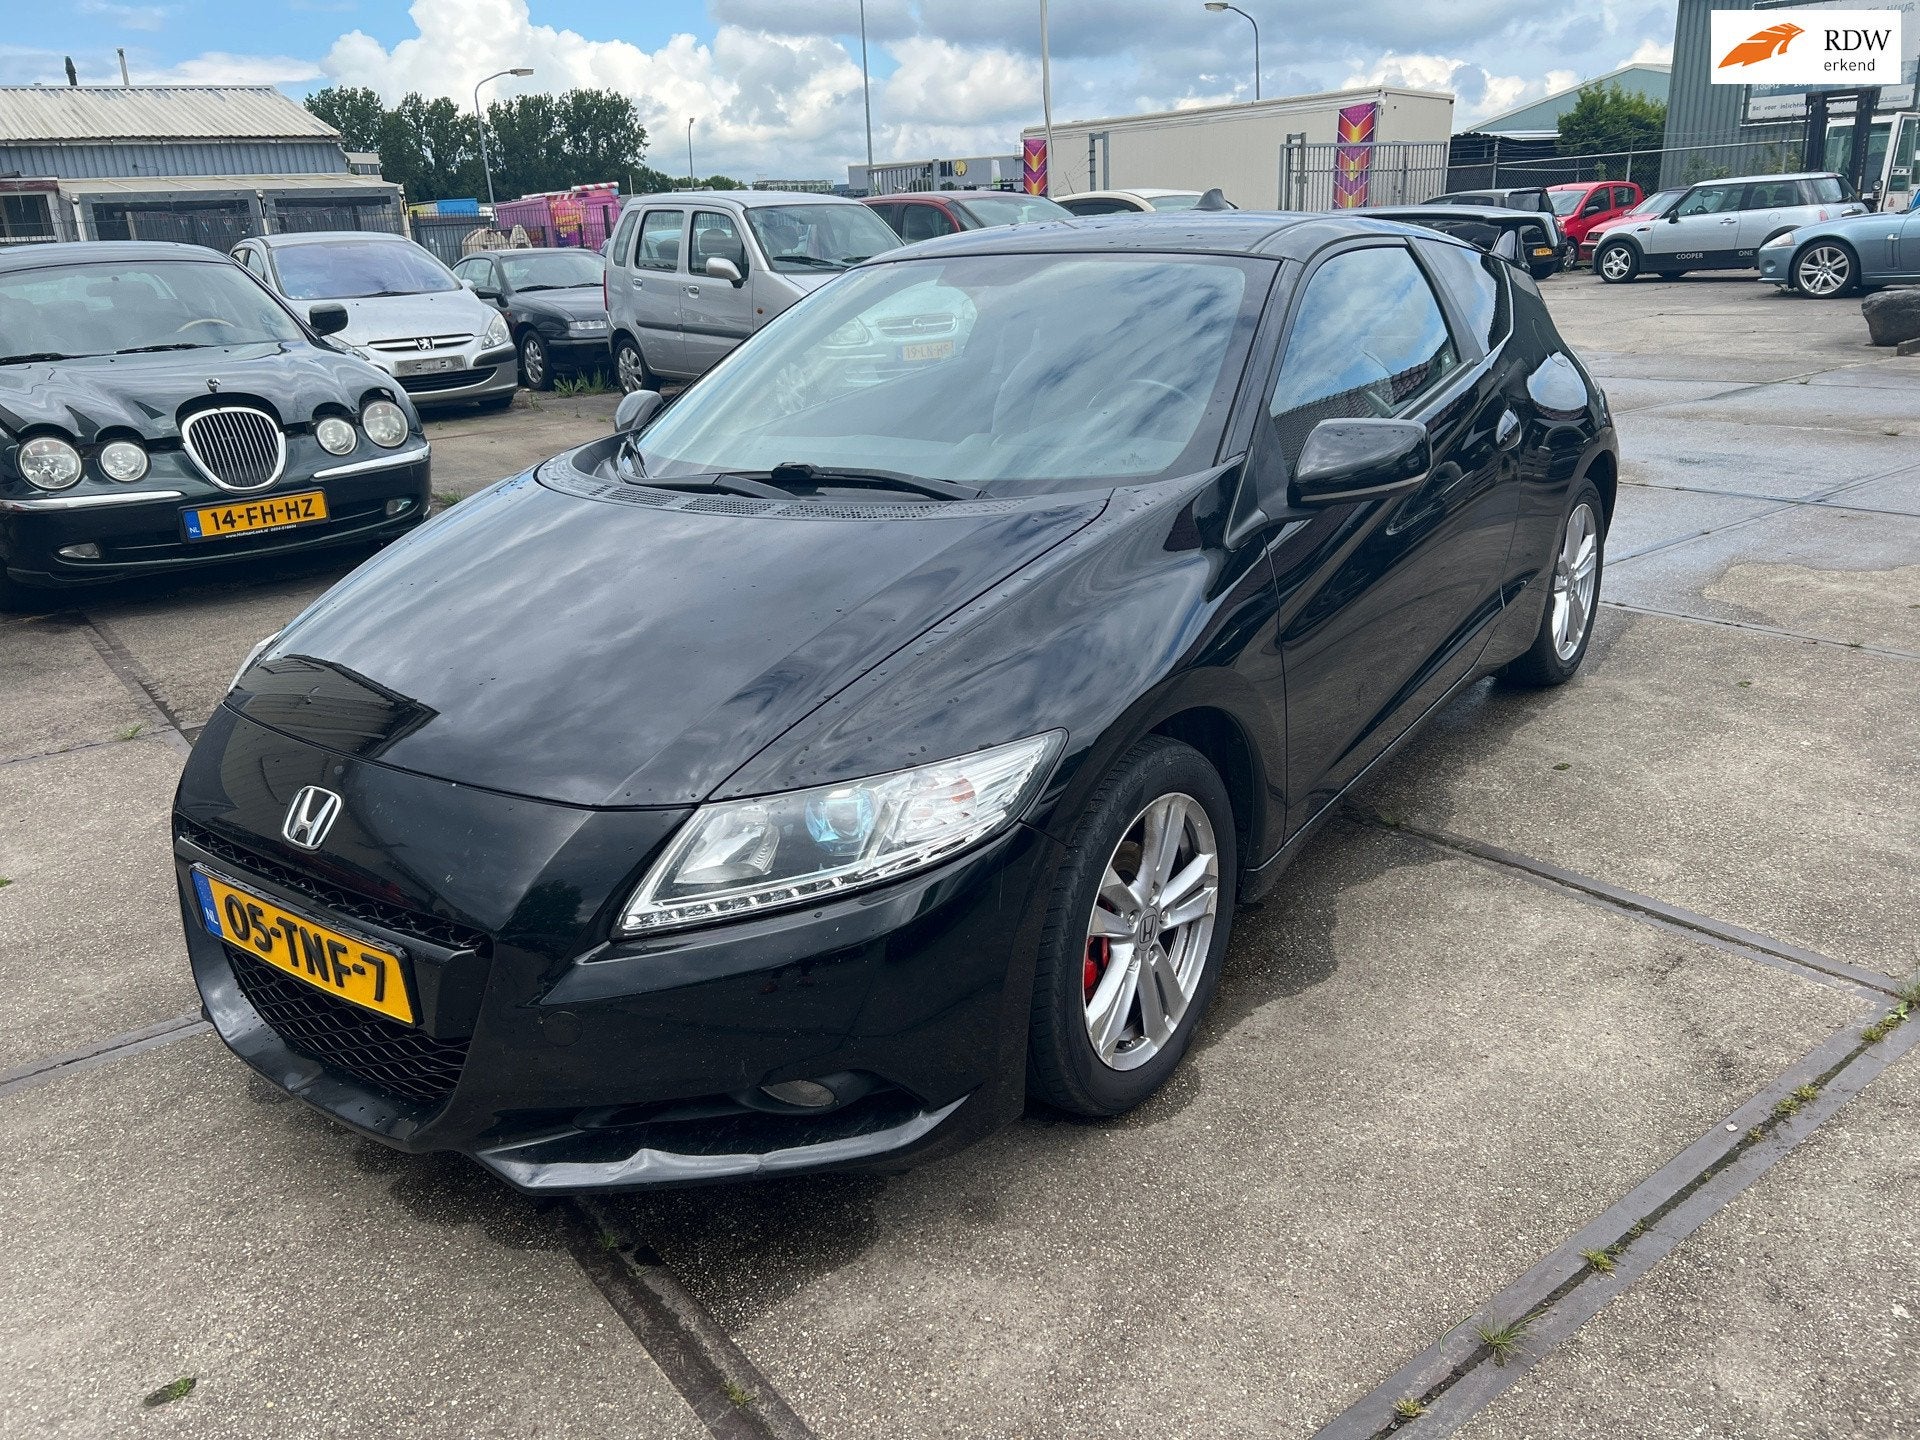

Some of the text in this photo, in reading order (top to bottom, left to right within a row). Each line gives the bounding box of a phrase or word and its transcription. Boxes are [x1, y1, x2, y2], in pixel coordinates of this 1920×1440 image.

[1676, 249, 1754, 260] COOPER ONE
[189, 498, 315, 534] NL 14-FH-HZ
[204, 893, 386, 1002] NL 05-TNF-7
